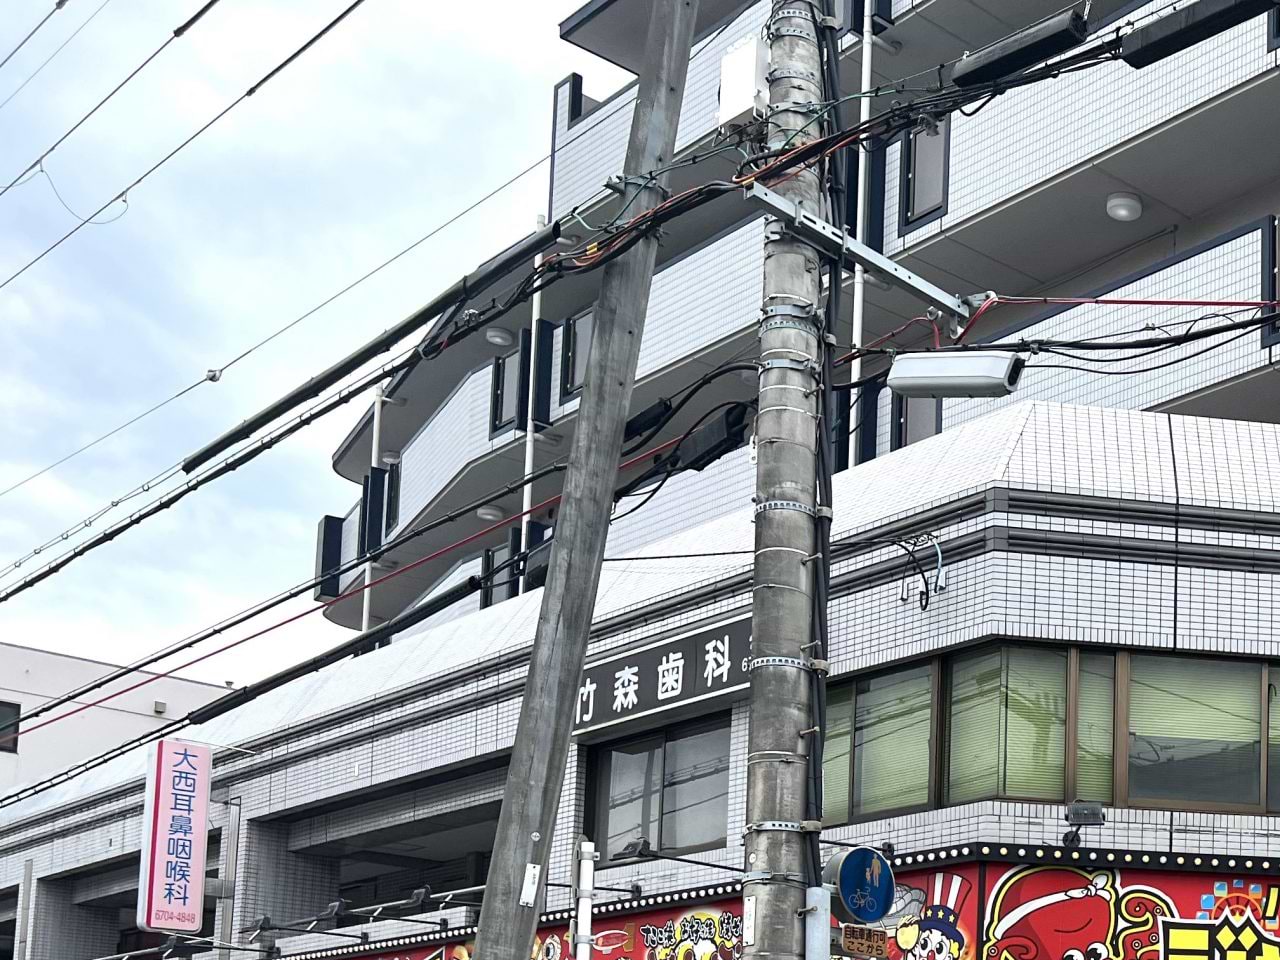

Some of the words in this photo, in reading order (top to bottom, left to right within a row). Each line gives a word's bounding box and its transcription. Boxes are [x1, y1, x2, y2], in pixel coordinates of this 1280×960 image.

[575, 634, 732, 725] 竹森歯科
[163, 748, 199, 907] 大西耳鼻咽喉科
[155, 909, 196, 924] 6704-4848
[847, 941, 884, 956] ここから
